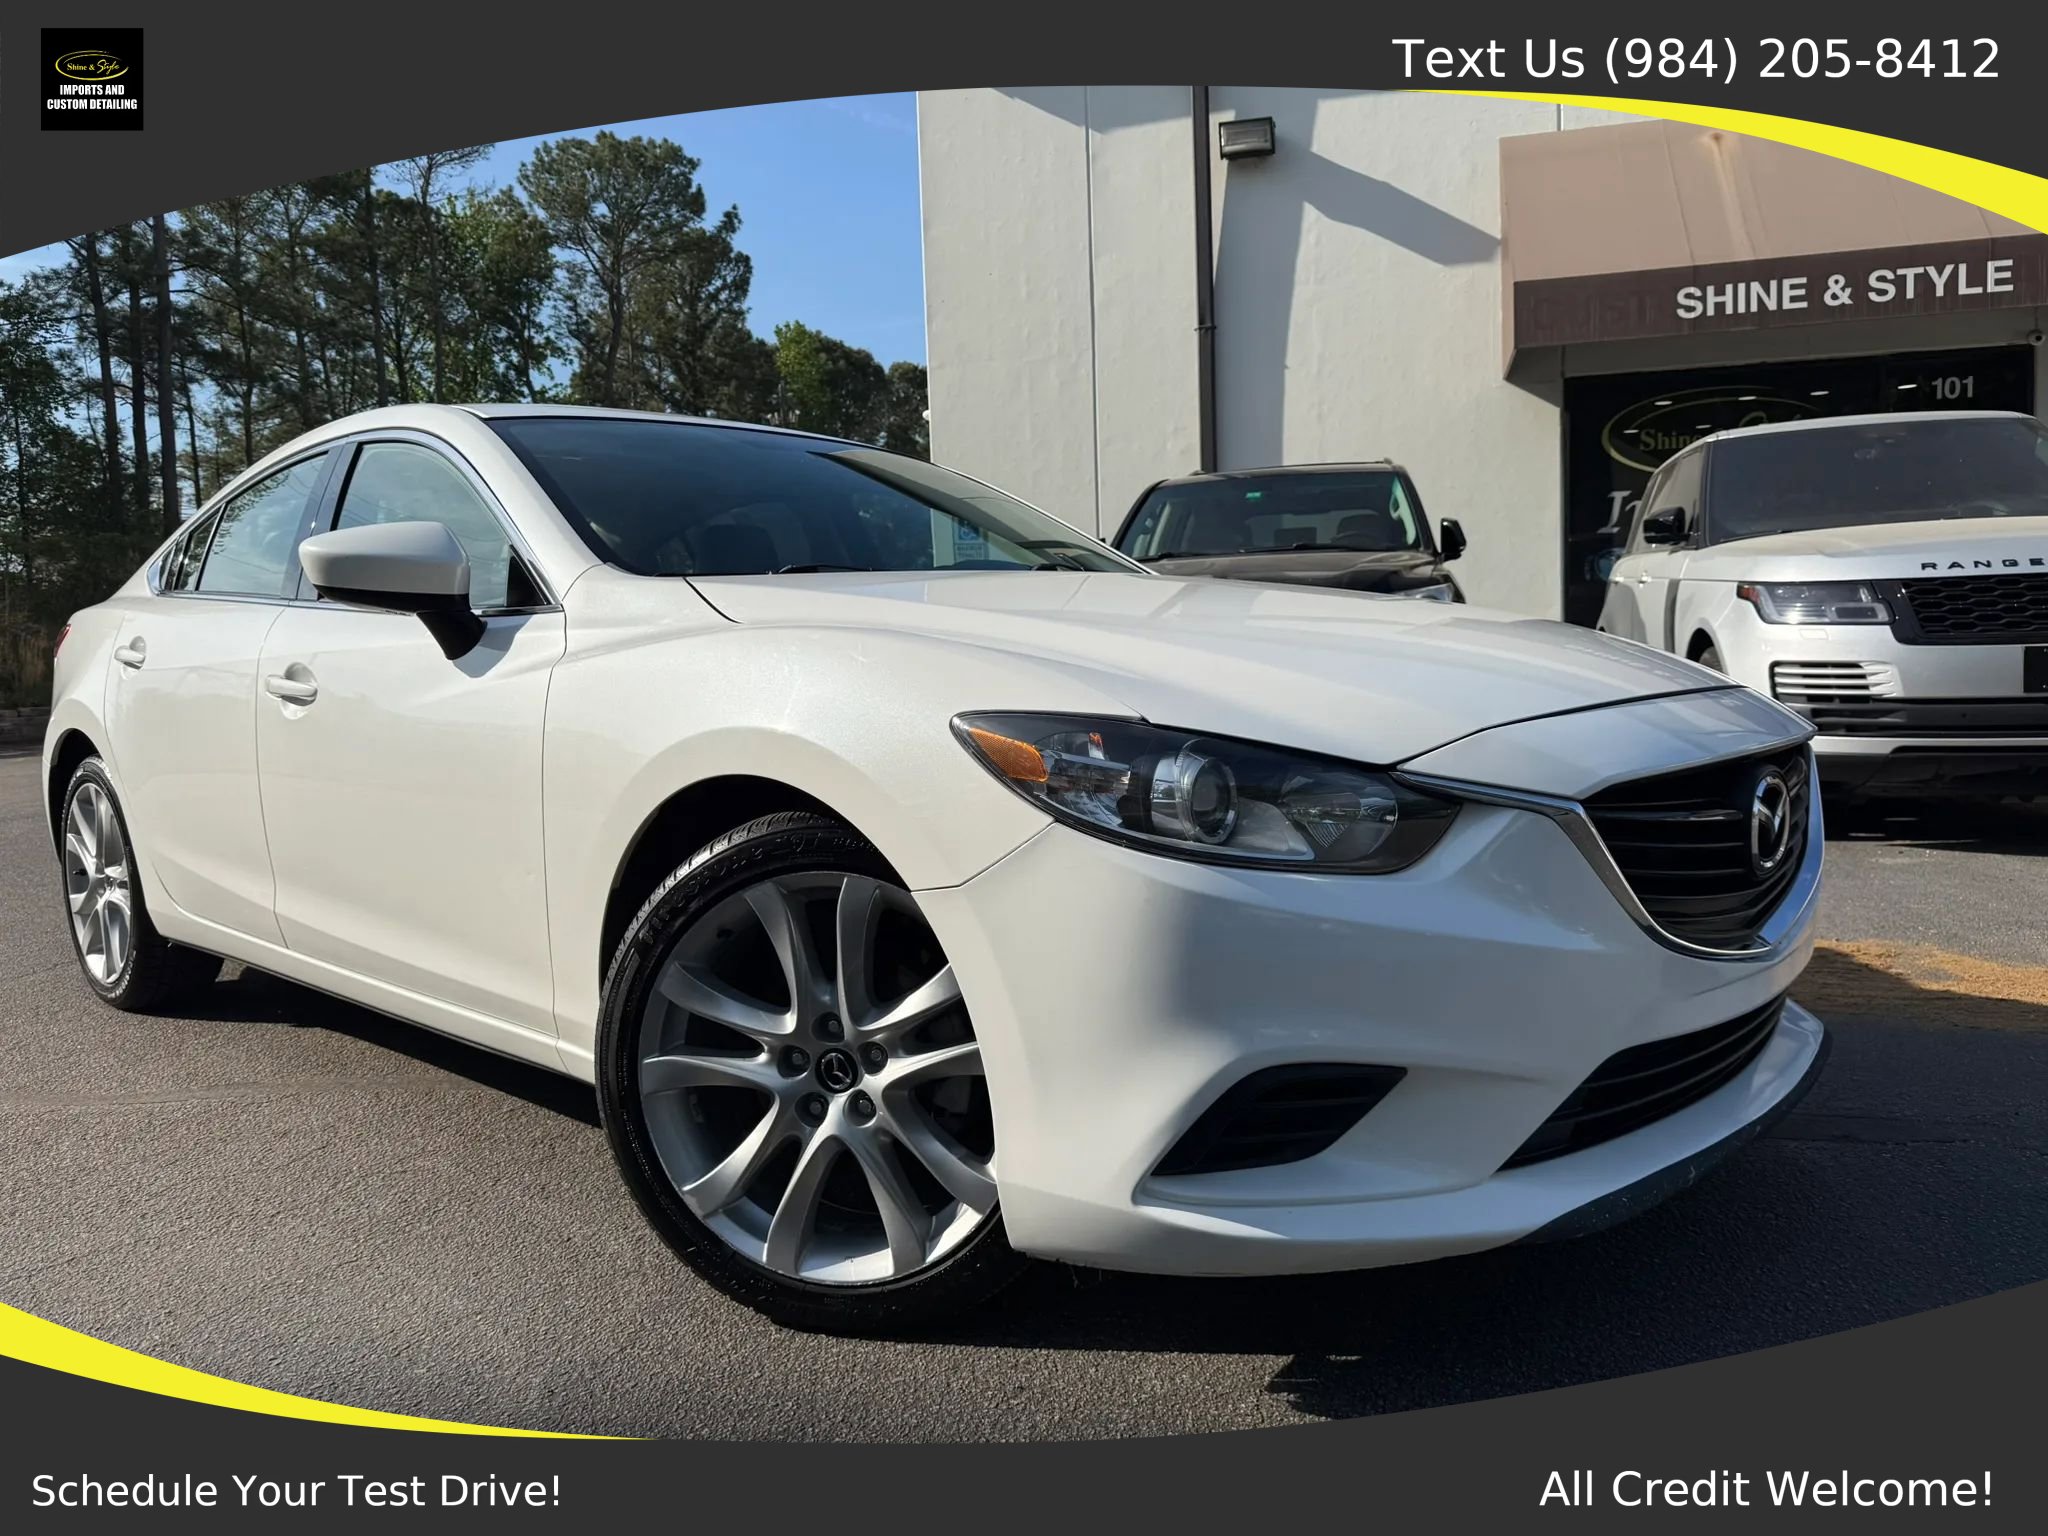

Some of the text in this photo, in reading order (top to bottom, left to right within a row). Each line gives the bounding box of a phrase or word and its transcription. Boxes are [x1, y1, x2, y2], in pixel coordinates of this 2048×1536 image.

[1676, 276, 1808, 319] SHINE
[1824, 274, 1853, 306] &
[1867, 259, 2014, 302] STYLE
[1931, 375, 1974, 400] 101
[1920, 557, 2046, 571] RANGE
